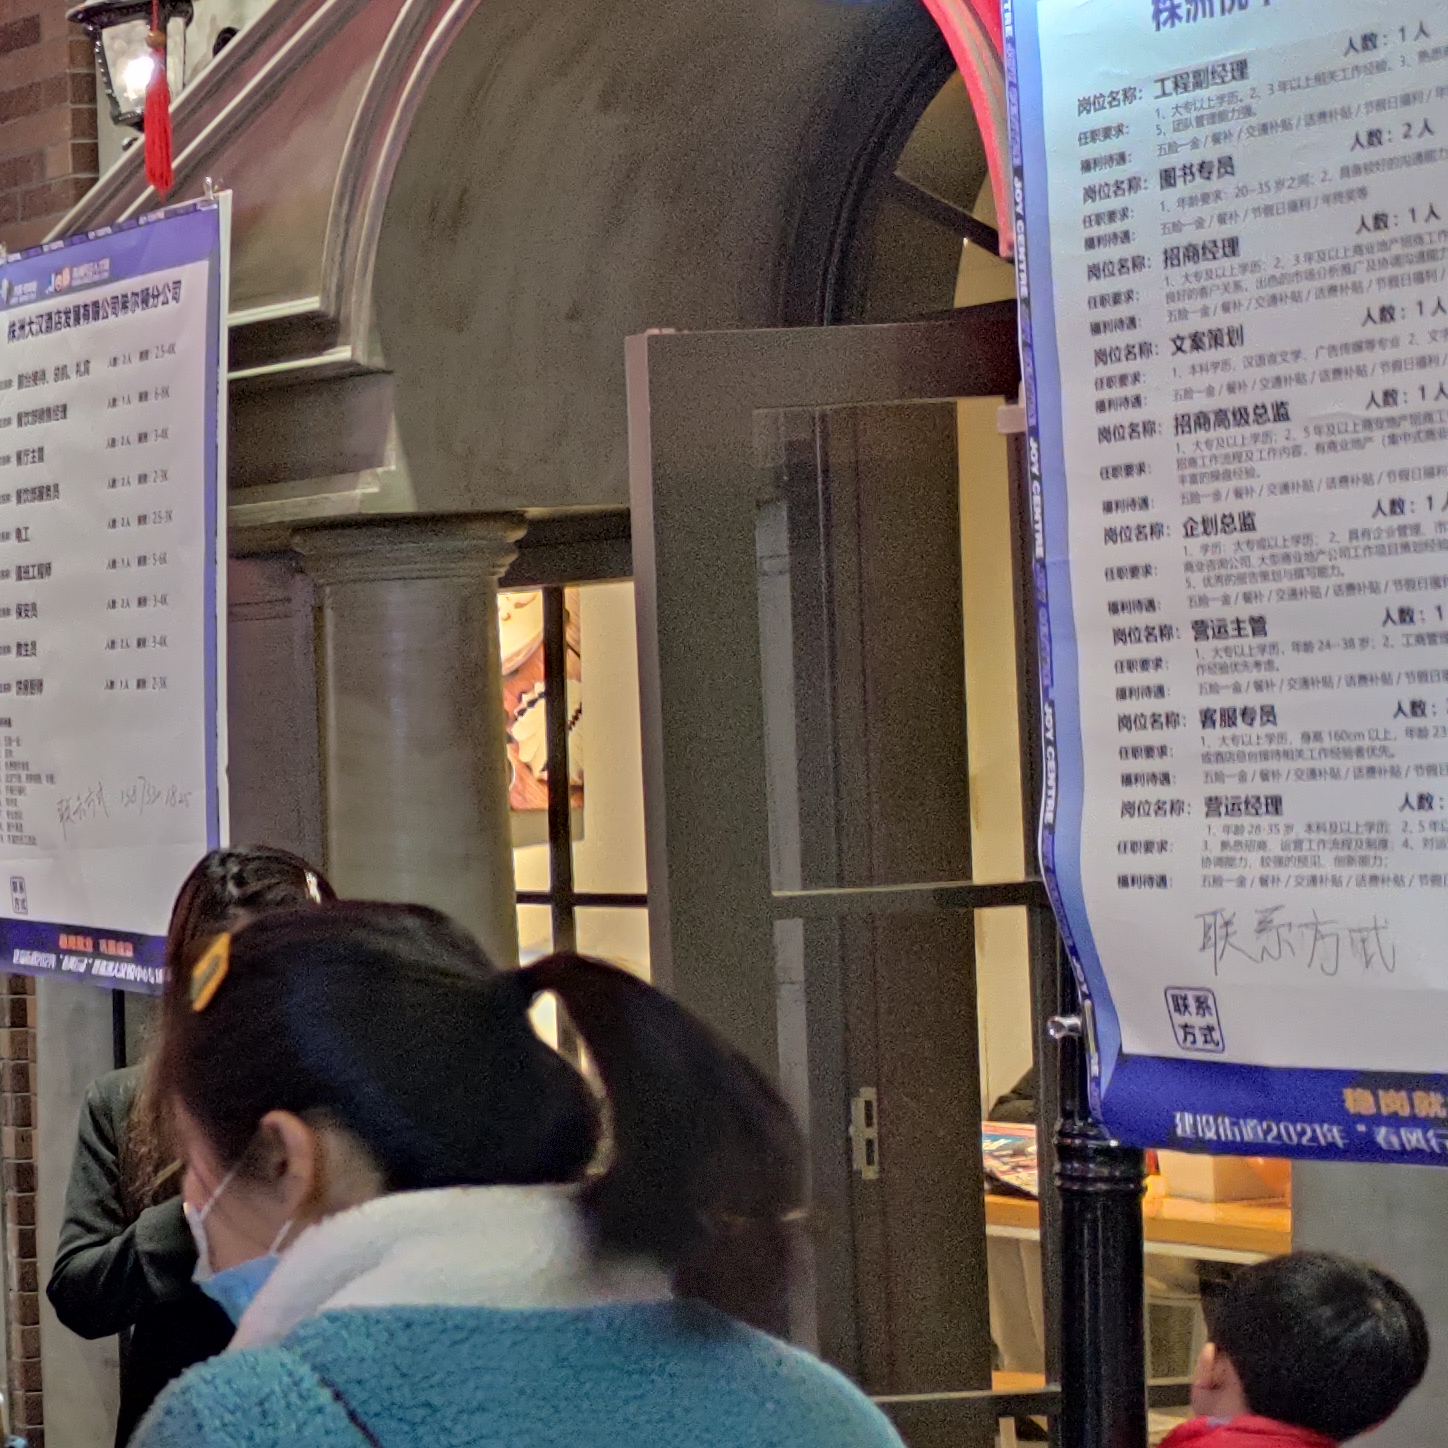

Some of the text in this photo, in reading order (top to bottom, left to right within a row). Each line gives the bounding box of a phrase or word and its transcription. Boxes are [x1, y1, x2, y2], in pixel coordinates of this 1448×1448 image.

[1153, 57, 1250, 100] 工程副经理
[1158, 154, 1236, 192] 图书专员
[1012, 172, 1029, 300] JOY CENTRE
[1162, 235, 1241, 270] 招商经理
[1173, 400, 1292, 438] 招商高级总监
[1028, 434, 1044, 560] JOY CENTRE
[1182, 509, 1258, 540] 企划总监
[1190, 614, 1269, 643] 营运主管
[1198, 703, 1279, 731] 客服专员
[1043, 700, 1055, 825] JOY CENTRE
[1203, 793, 1285, 819] 营运经理
[1194, 904, 1396, 977] 联系方式
[1170, 992, 1214, 1019] 联系
[1177, 1022, 1221, 1048] 方式
